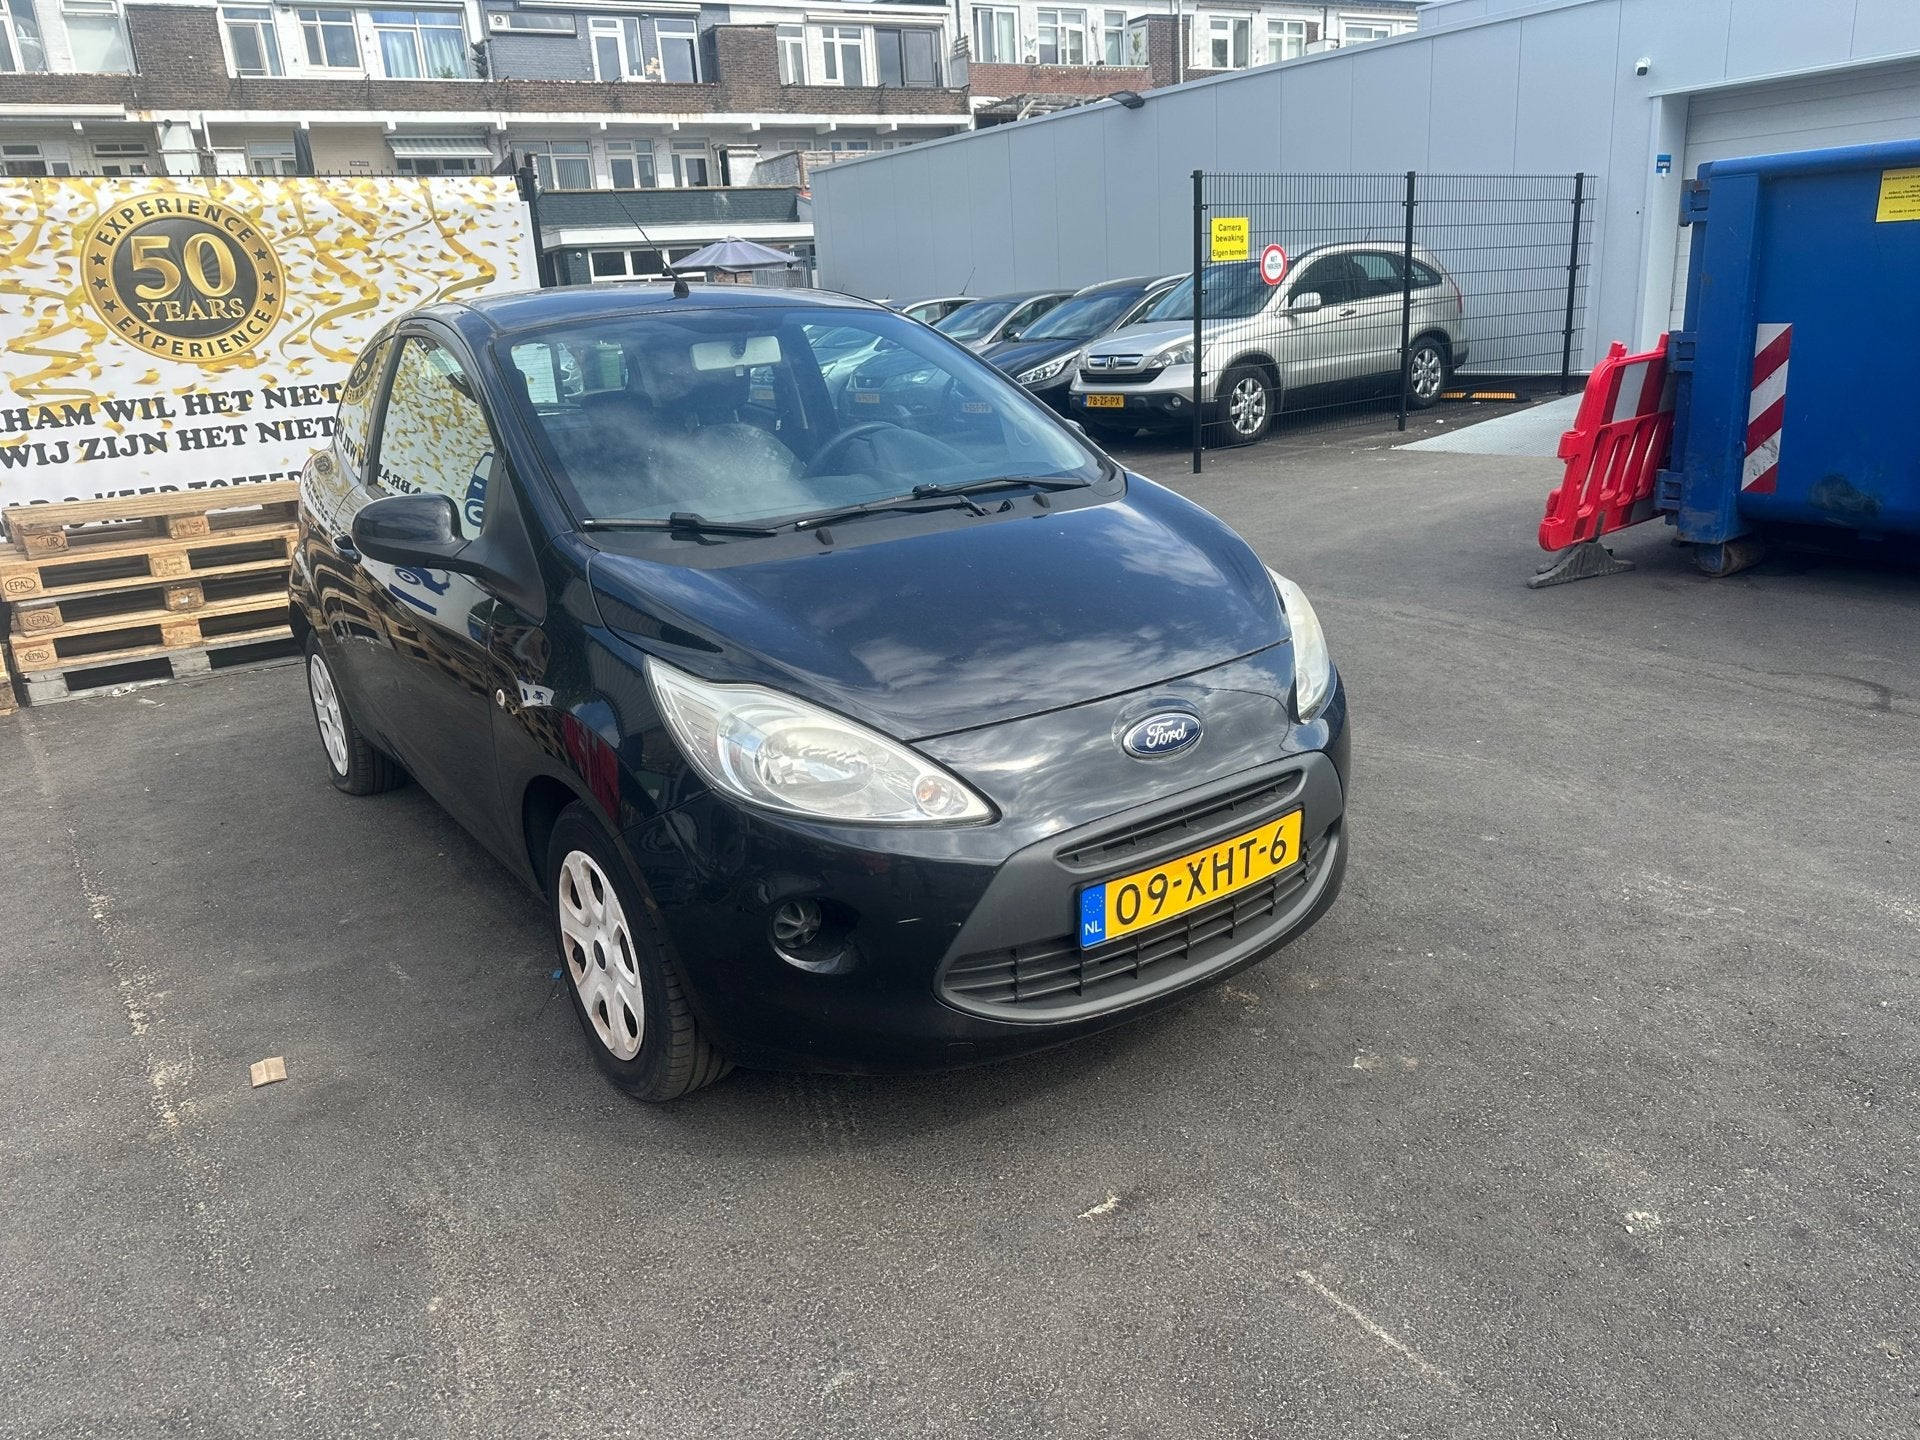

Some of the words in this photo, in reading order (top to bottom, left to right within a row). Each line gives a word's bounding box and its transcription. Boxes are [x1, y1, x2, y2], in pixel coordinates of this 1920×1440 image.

[95, 198, 255, 247] EXPERIENCE
[1218, 224, 1242, 232] Camera
[1215, 234, 1244, 243] bewaking
[1212, 249, 1229, 258] Eigen
[1229, 248, 1247, 256] terrein
[130, 232, 237, 300] 50
[137, 297, 246, 323] YEARS
[116, 308, 272, 358] EXPERIENCE
[0, 403, 95, 433] HAM
[100, 396, 176, 423] WIL
[182, 389, 254, 416] HET
[261, 382, 342, 410] NIET
[1088, 395, 1121, 406] 78-ZF-PX
[0, 440, 70, 469] WIJ
[78, 431, 168, 461] ZIJN
[176, 423, 248, 451] HET
[255, 415, 335, 443] NIET
[8, 579, 32, 590] EPAL
[31, 614, 53, 626] EPAL
[26, 650, 47, 661] EPAL
[1145, 720, 1188, 749] Ford
[1115, 824, 1288, 926] 09-XHT-6
[1084, 919, 1103, 936] NL
